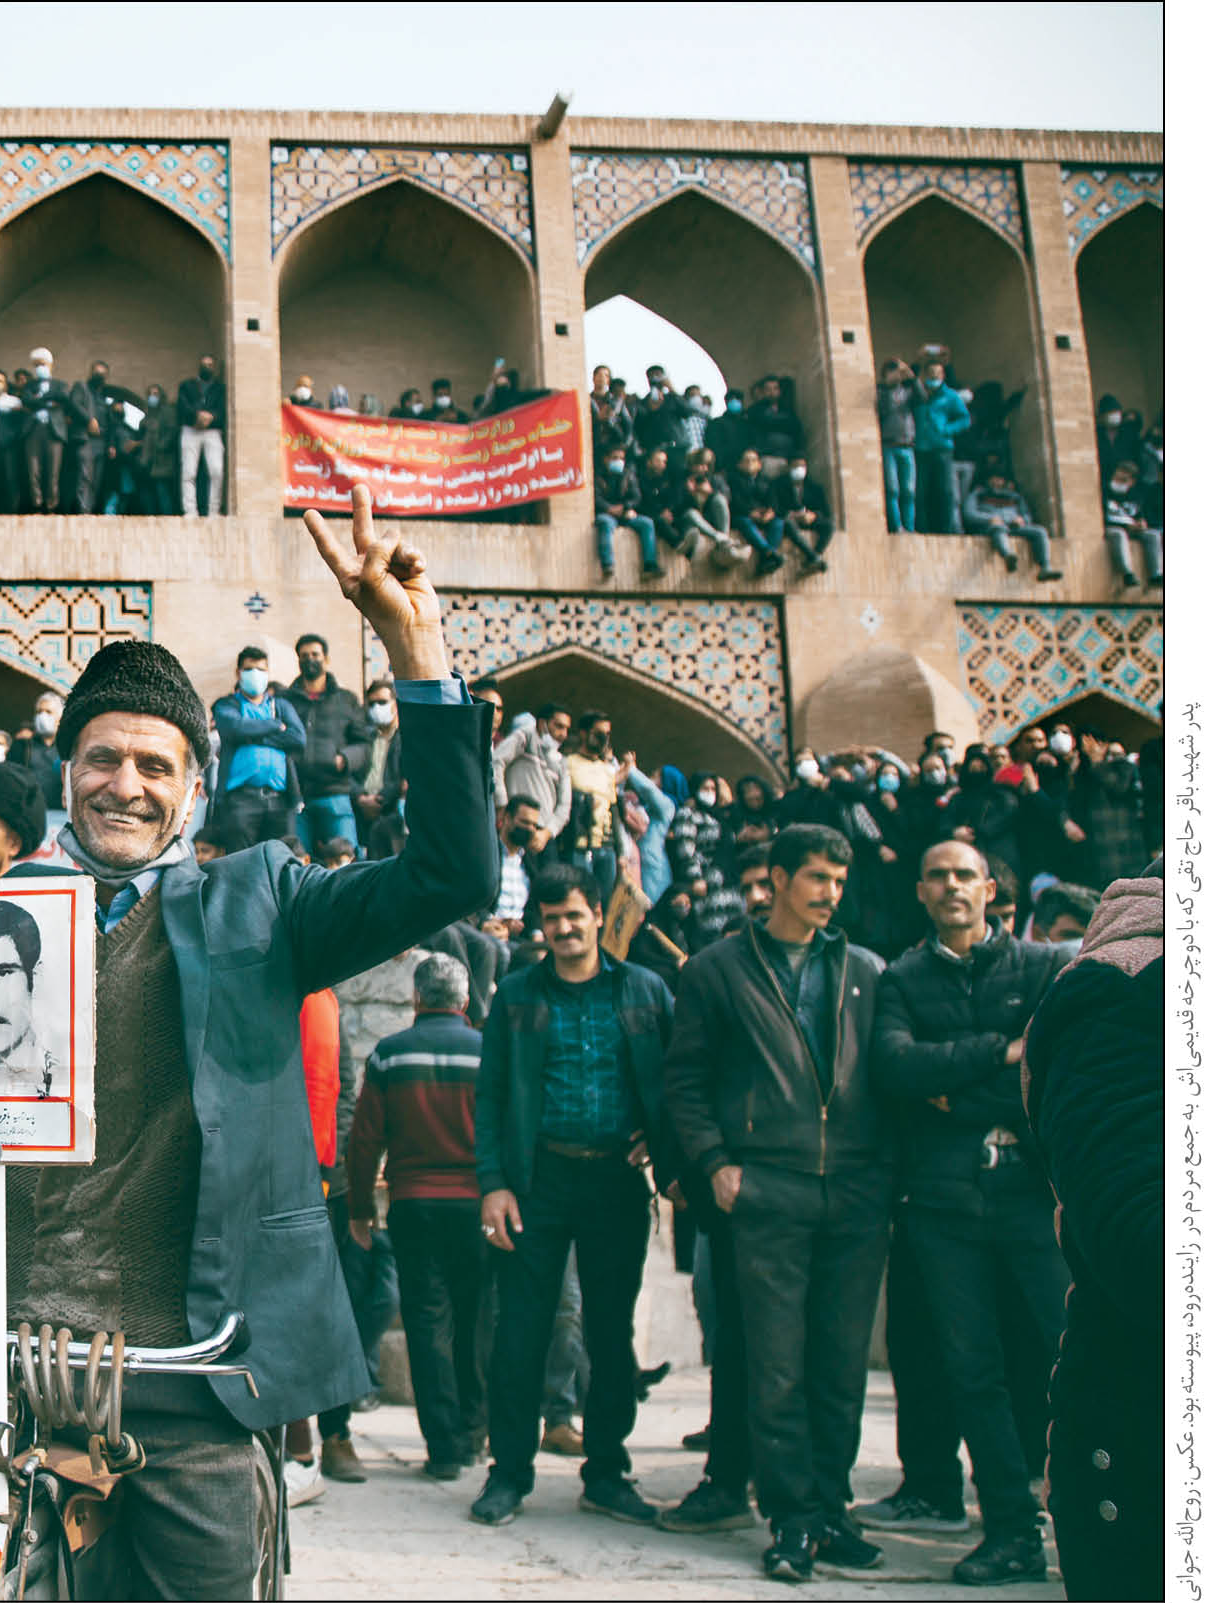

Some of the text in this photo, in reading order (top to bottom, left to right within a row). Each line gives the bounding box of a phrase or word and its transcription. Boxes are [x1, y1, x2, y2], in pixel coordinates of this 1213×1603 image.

[540, 446, 564, 463] با
[420, 472, 444, 487] به
[529, 467, 583, 489] زاینده
[502, 482, 528, 498] رود
